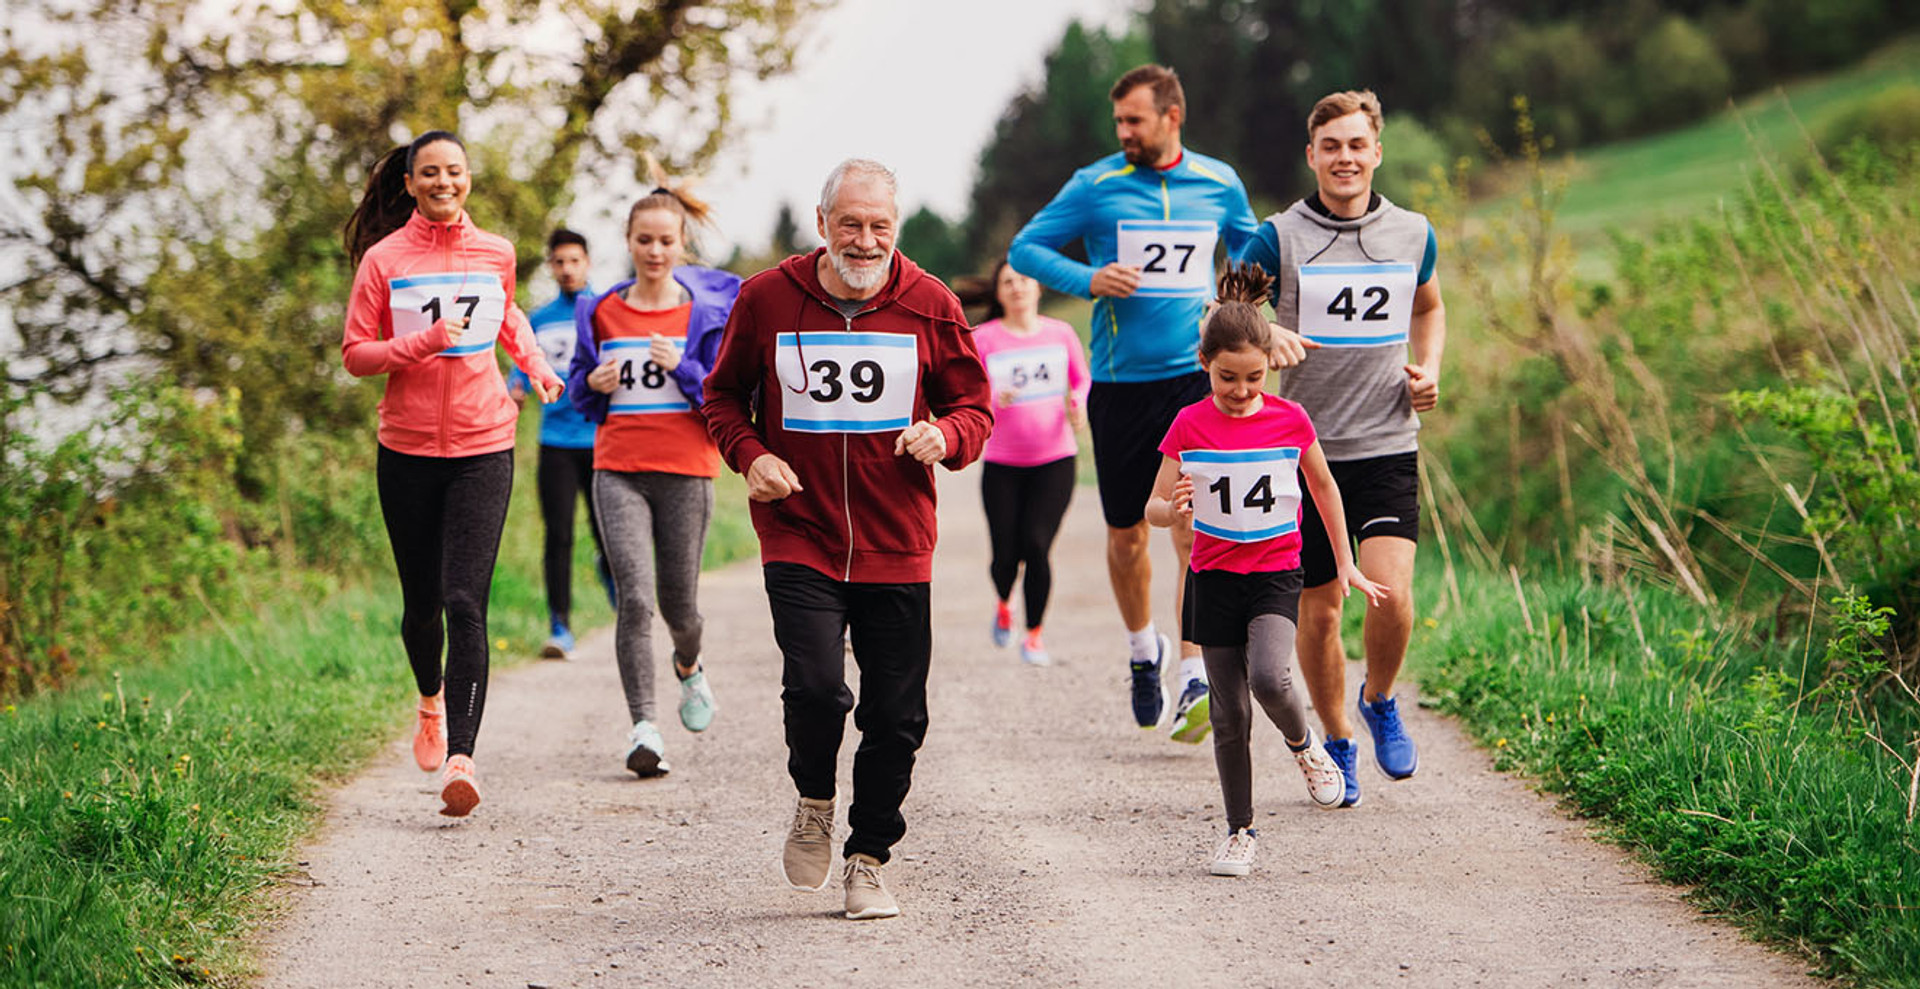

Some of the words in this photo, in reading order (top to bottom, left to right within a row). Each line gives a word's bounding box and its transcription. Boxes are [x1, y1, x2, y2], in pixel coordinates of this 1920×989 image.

[1143, 244, 1196, 274] 27
[421, 296, 480, 330] 17
[1327, 286, 1390, 321] 42
[619, 360, 666, 390] 48
[809, 360, 884, 403] 39
[1012, 363, 1050, 389] 54
[1209, 474, 1276, 515] 14
